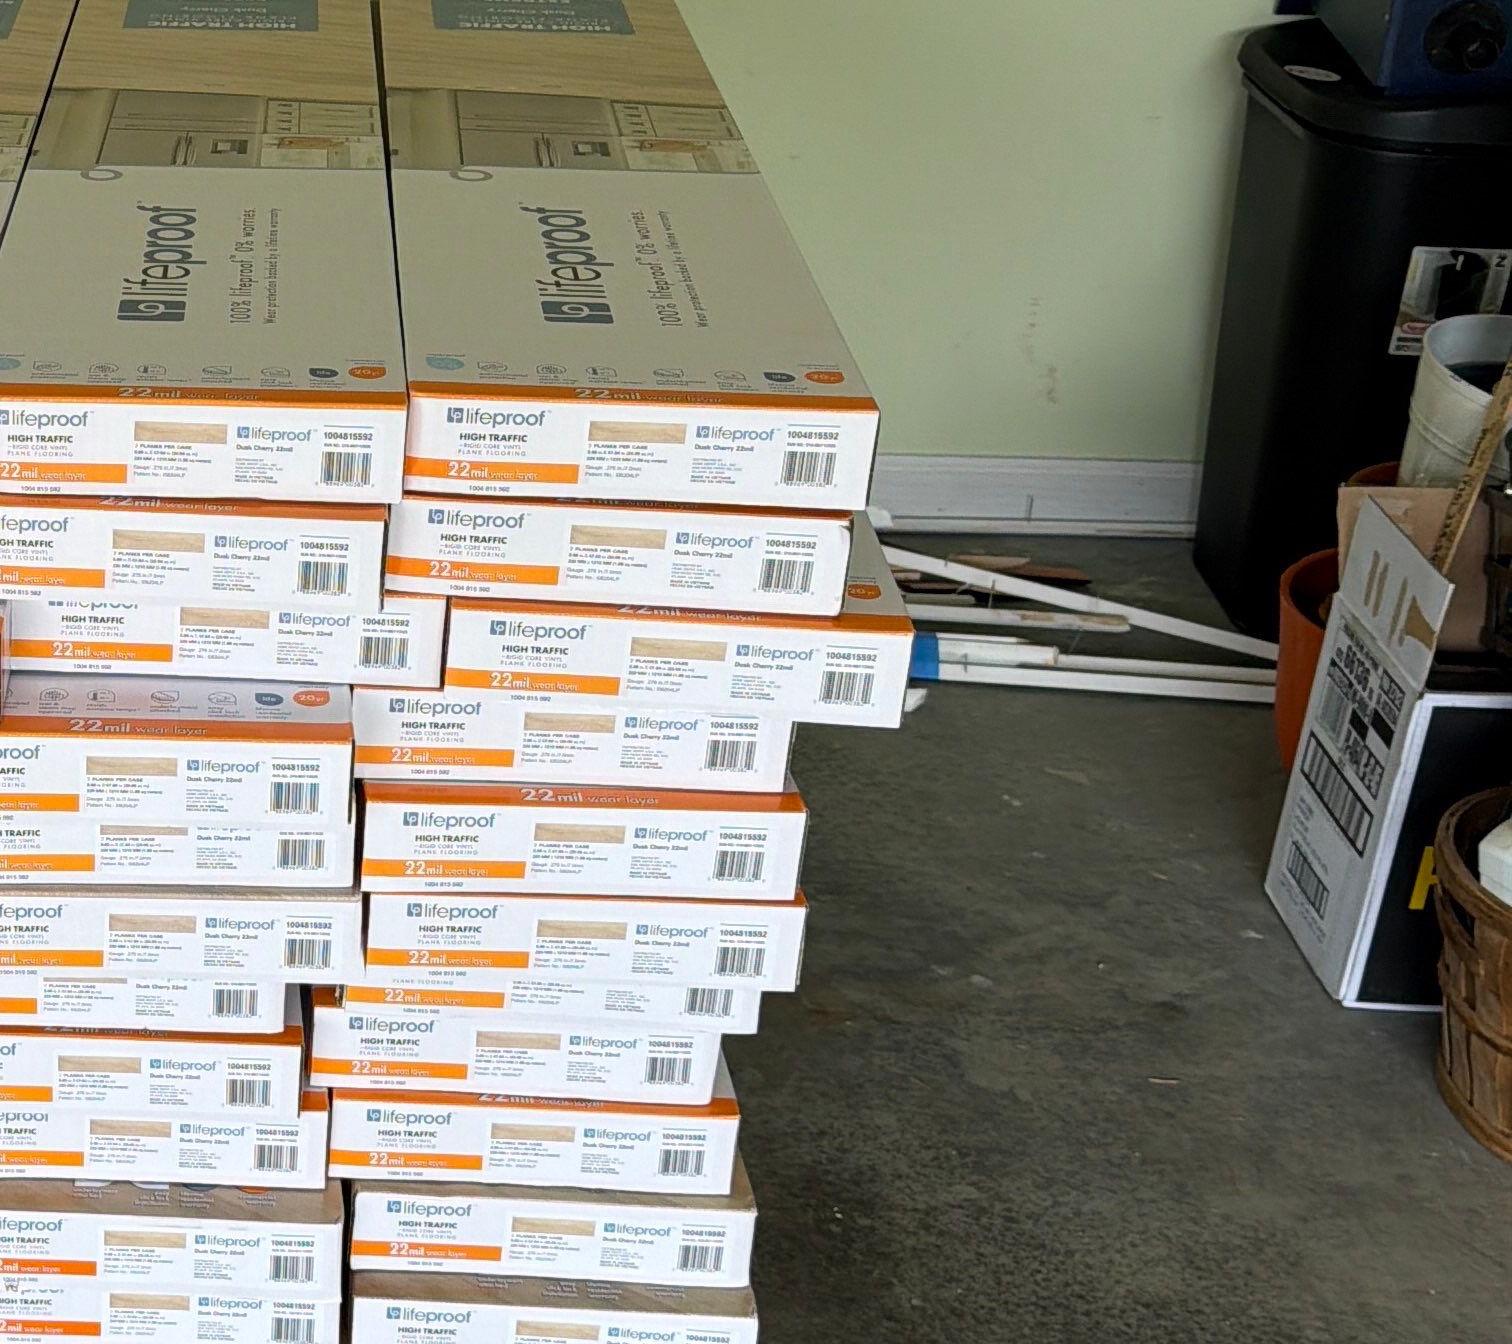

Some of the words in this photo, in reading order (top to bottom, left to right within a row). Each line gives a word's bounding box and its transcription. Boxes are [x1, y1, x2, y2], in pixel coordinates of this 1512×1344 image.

[121, 206, 207, 296] lifeproof
[519, 206, 615, 299] lifeproof
[230, 301, 252, 324] 100%
[656, 303, 683, 327] 100%
[12, 410, 88, 430] lifeproof
[466, 408, 544, 428] lifeproof
[7, 434, 32, 443] HIGH
[36, 434, 73, 444] TRAFFIC
[251, 427, 311, 443] lifeproof
[324, 431, 375, 442] 1004815592
[459, 432, 485, 442] HIGH
[489, 432, 527, 443] TRAFFIC
[711, 427, 774, 442] lifeproof
[446, 511, 524, 530] lifeproof
[16, 539, 53, 547] TRAFFIC
[228, 537, 288, 553] lifeproof
[300, 541, 351, 552] 1004815592
[439, 534, 465, 543] HIGH
[469, 535, 507, 544] TRAFFIC
[690, 534, 753, 549] lifeproof
[766, 538, 818, 549] 1004815592
[61, 614, 86, 624] HIGH
[89, 615, 125, 624] TRAFFIC
[293, 613, 351, 628] lifeproof
[508, 622, 586, 641] lifeproof
[501, 645, 527, 654] HIGH
[531, 645, 569, 655] TRAFFIC
[751, 647, 814, 662] lifeproof
[407, 699, 481, 717] lifeproof
[401, 721, 426, 730] HIGH
[429, 722, 465, 730] TRAFFIC
[421, 812, 495, 830] lifeproof
[415, 833, 440, 843] HIGH
[443, 834, 479, 843] TRAFFIC
[424, 903, 498, 921] lifeproof
[366, 1018, 435, 1035] lifeproof
[383, 1110, 452, 1127] lifeproof
[405, 1202, 471, 1218] lifeproof
[403, 1309, 472, 1324] lifeproof
